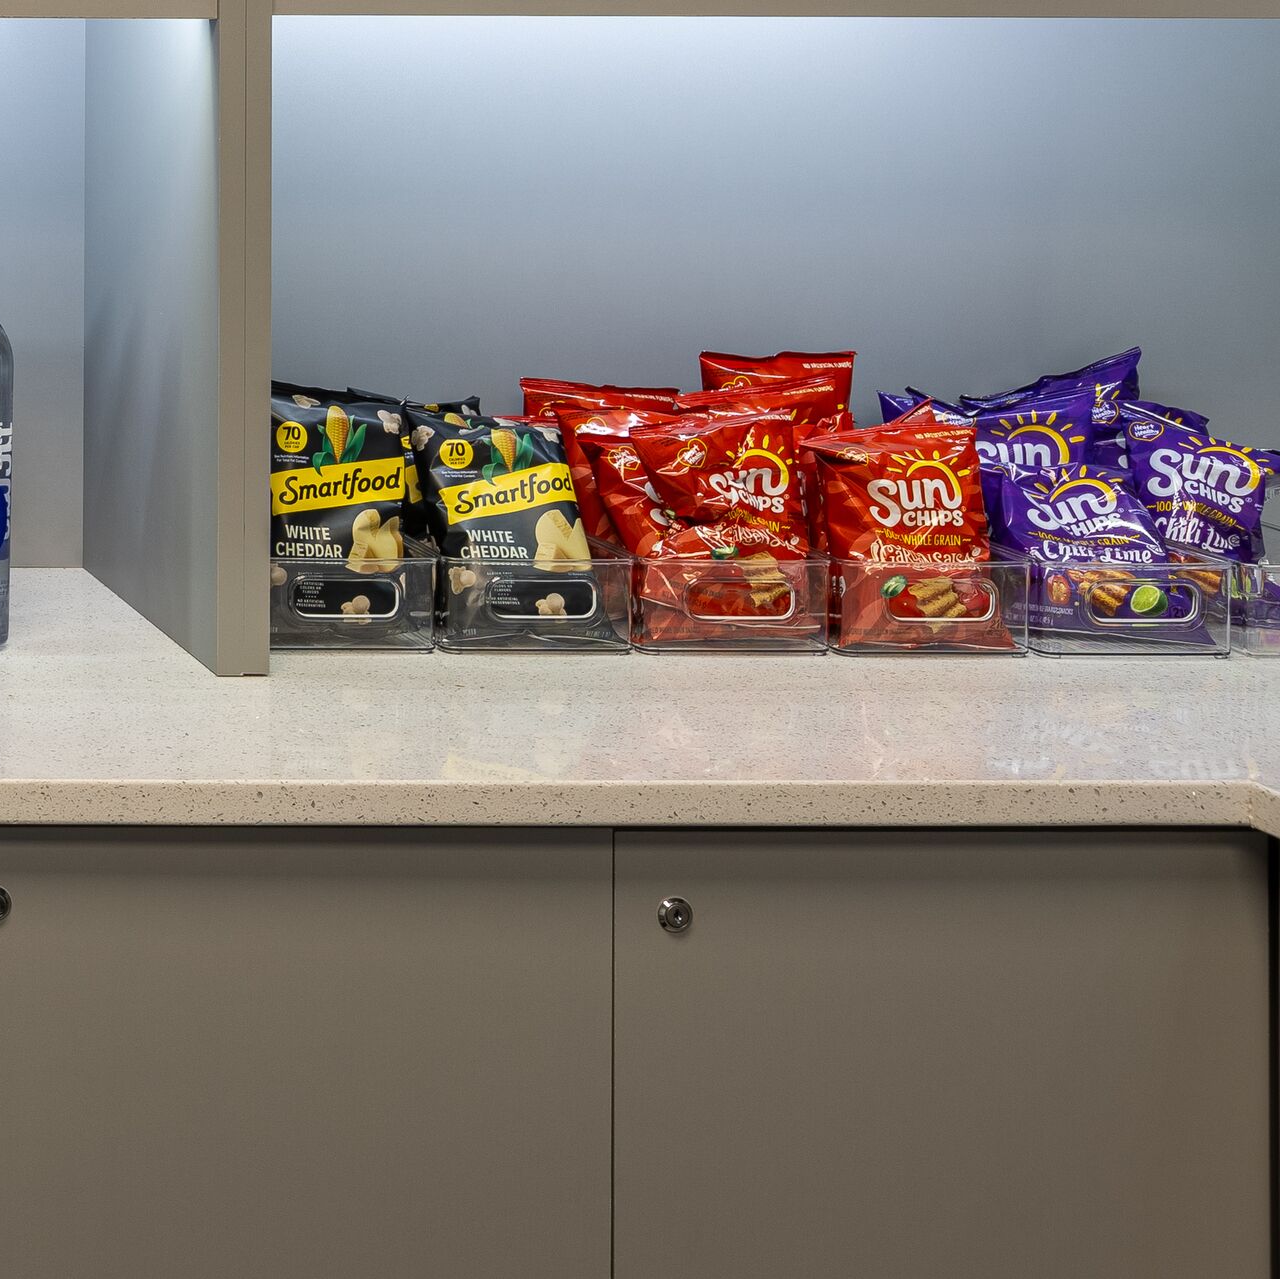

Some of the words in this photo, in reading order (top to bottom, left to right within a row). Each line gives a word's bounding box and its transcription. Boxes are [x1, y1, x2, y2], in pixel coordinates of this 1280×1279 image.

[283, 426, 301, 441] 70
[1133, 424, 1154, 433] Heart
[1134, 428, 1159, 439] Healthy
[448, 442, 467, 457] 70
[1146, 448, 1251, 499] Sun
[279, 466, 402, 506] Smartfood
[454, 472, 572, 515] Smartfood
[738, 486, 786, 514] CHIPS
[867, 476, 963, 527] Sun
[1185, 481, 1243, 514] CHIPS
[903, 508, 964, 527] CHIPS
[1026, 490, 1119, 529] Sun
[284, 524, 332, 541] WHITE
[1065, 513, 1119, 538] CHIPS
[466, 529, 515, 543] WHITE
[899, 533, 929, 545] WHOLE
[929, 533, 961, 546] GRAIN
[275, 542, 343, 558] CHEDDAR
[460, 545, 529, 559] CHEDDAR
[1043, 539, 1094, 559] Chili
[1100, 545, 1152, 564] Lime
